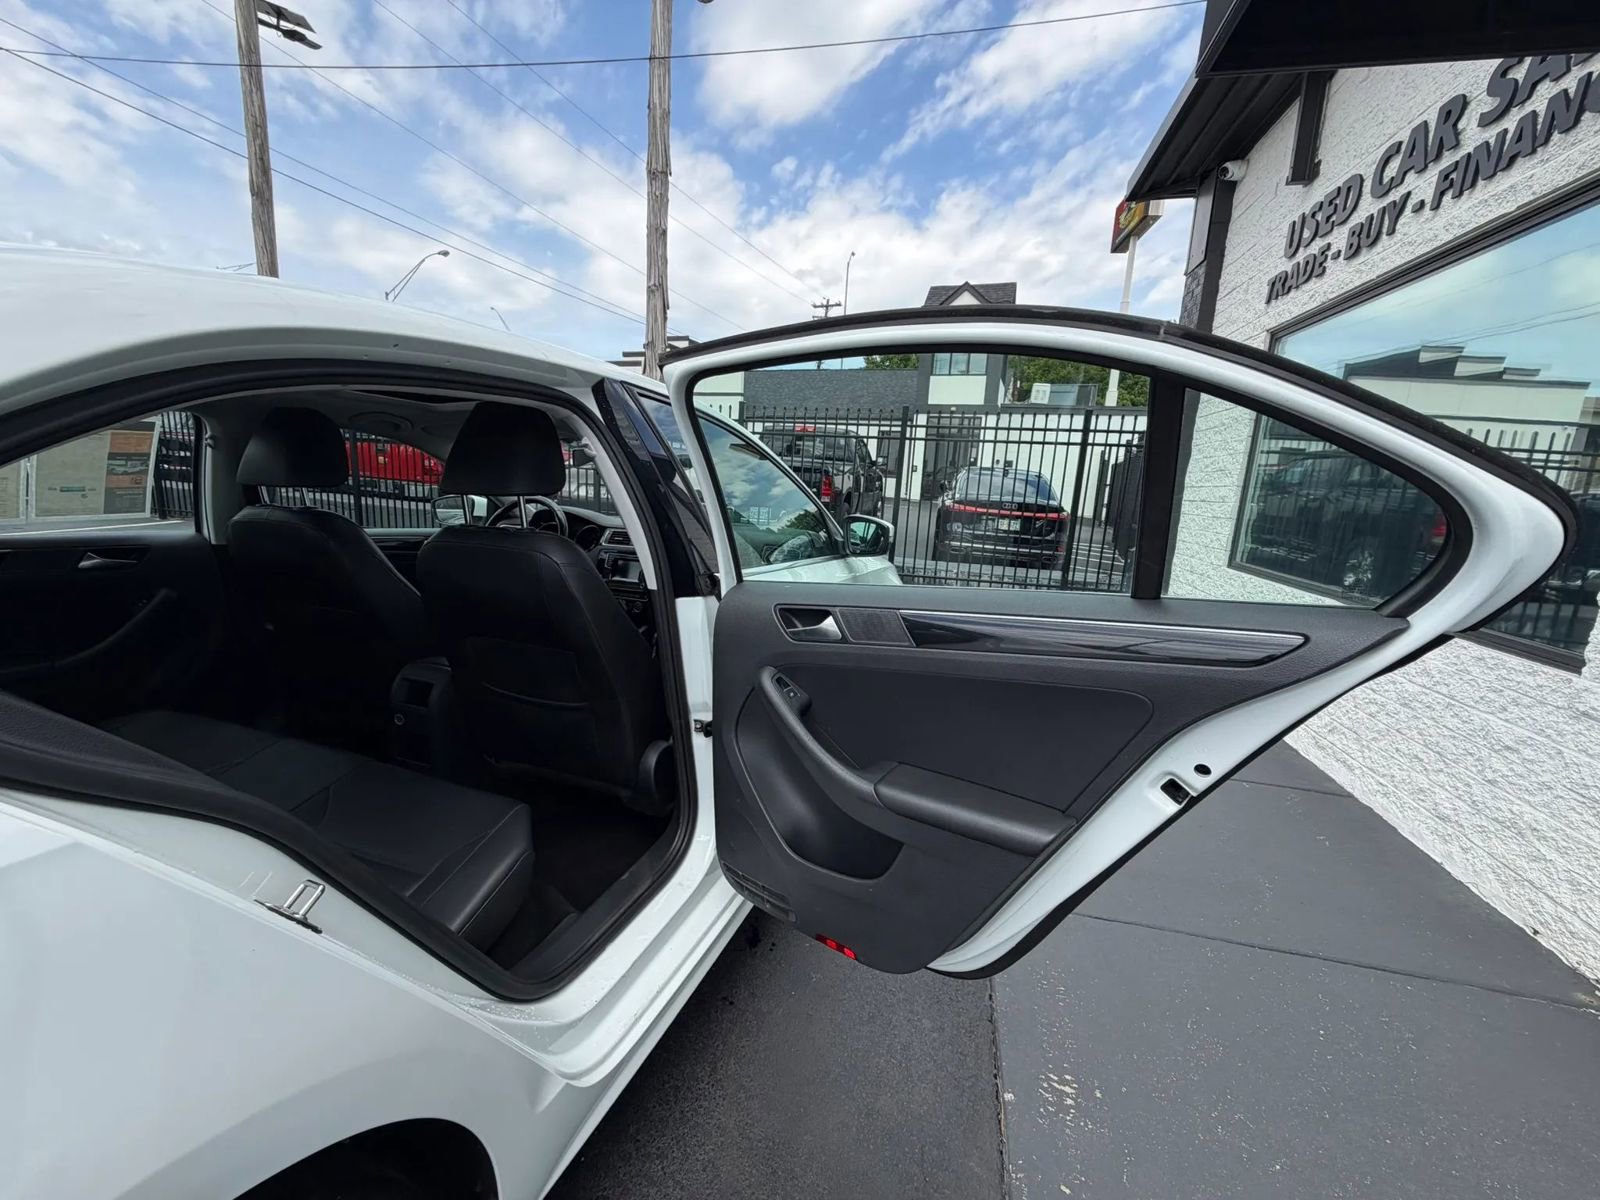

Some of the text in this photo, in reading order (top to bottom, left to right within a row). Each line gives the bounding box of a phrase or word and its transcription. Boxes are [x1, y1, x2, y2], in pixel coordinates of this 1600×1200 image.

[1284, 53, 1597, 259] USED CAR SA
